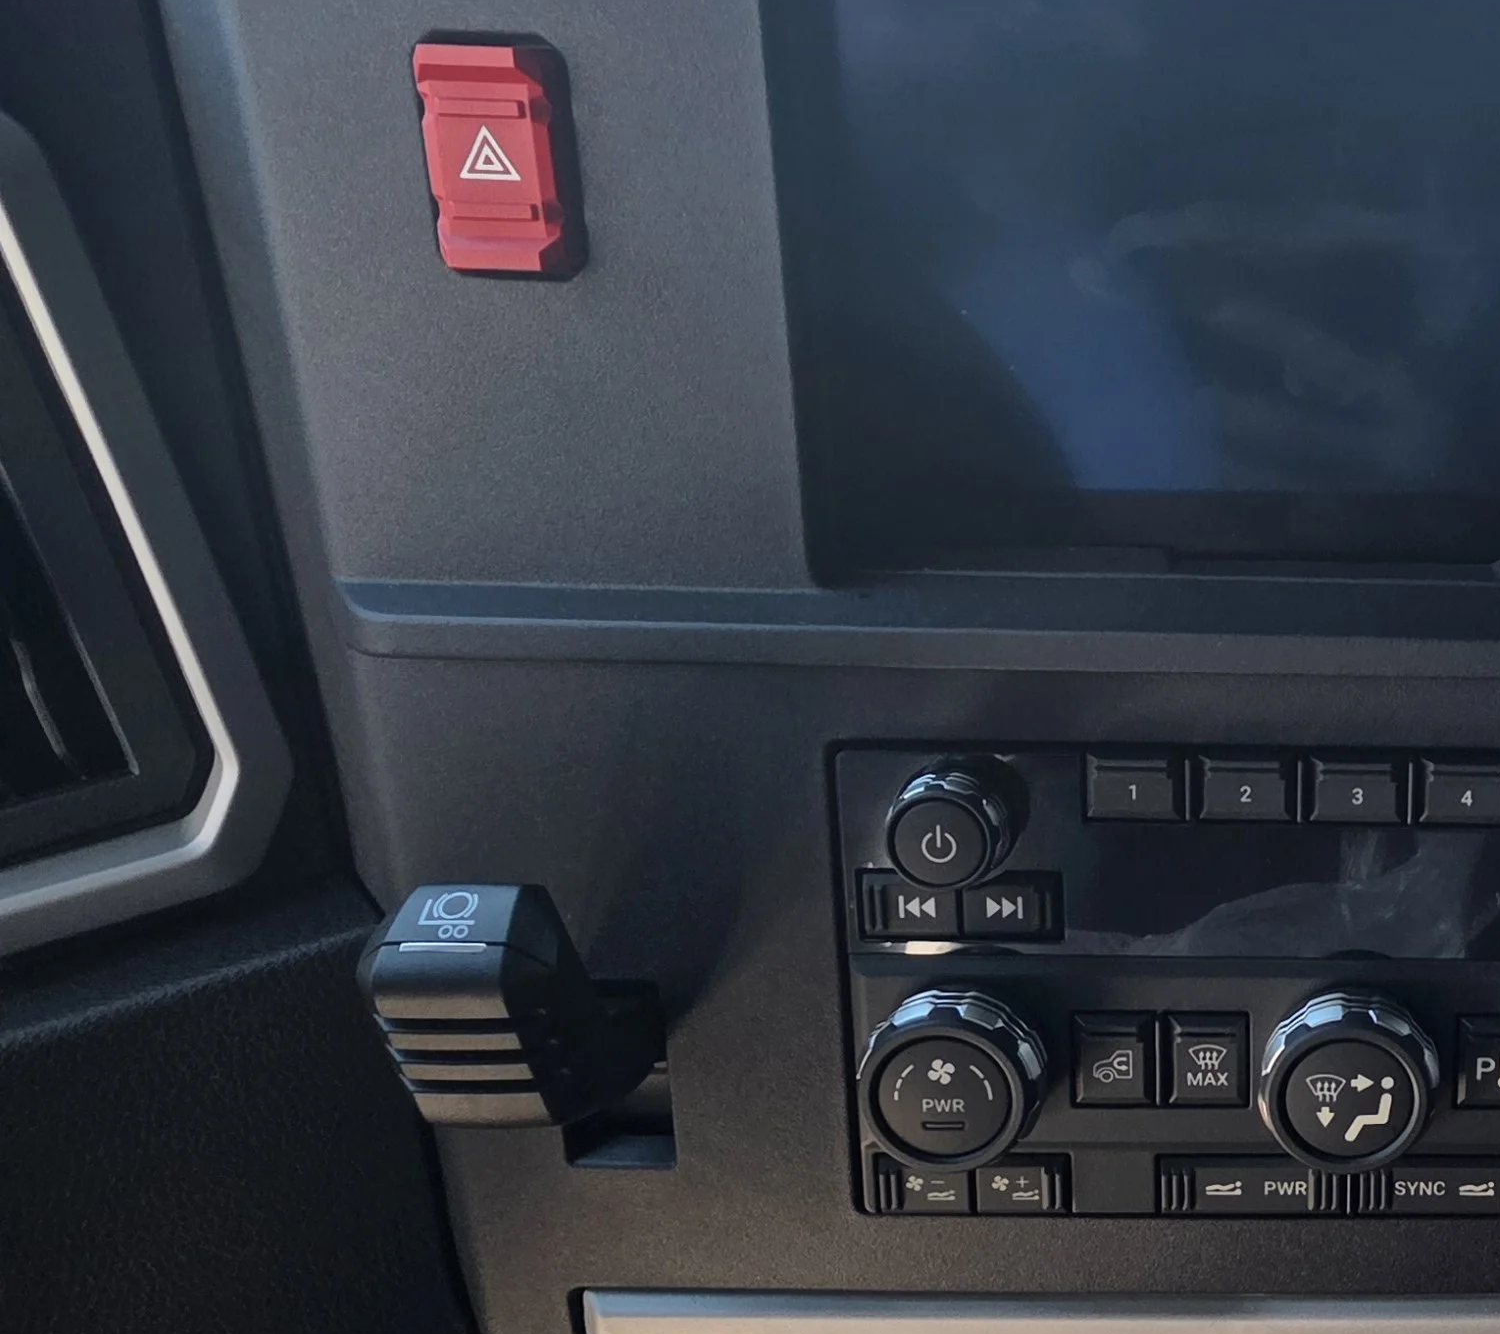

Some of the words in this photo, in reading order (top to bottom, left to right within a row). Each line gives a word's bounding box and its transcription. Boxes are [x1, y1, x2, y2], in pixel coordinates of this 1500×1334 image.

[1128, 784, 1138, 800] 1
[1239, 785, 1252, 803] 2
[1351, 787, 1364, 805] 3
[1460, 789, 1473, 807] 4
[1186, 1071, 1229, 1087] MAX
[921, 1098, 966, 1113] PWR
[1263, 1180, 1308, 1196] PWR
[1394, 1180, 1447, 1196] SYNC
